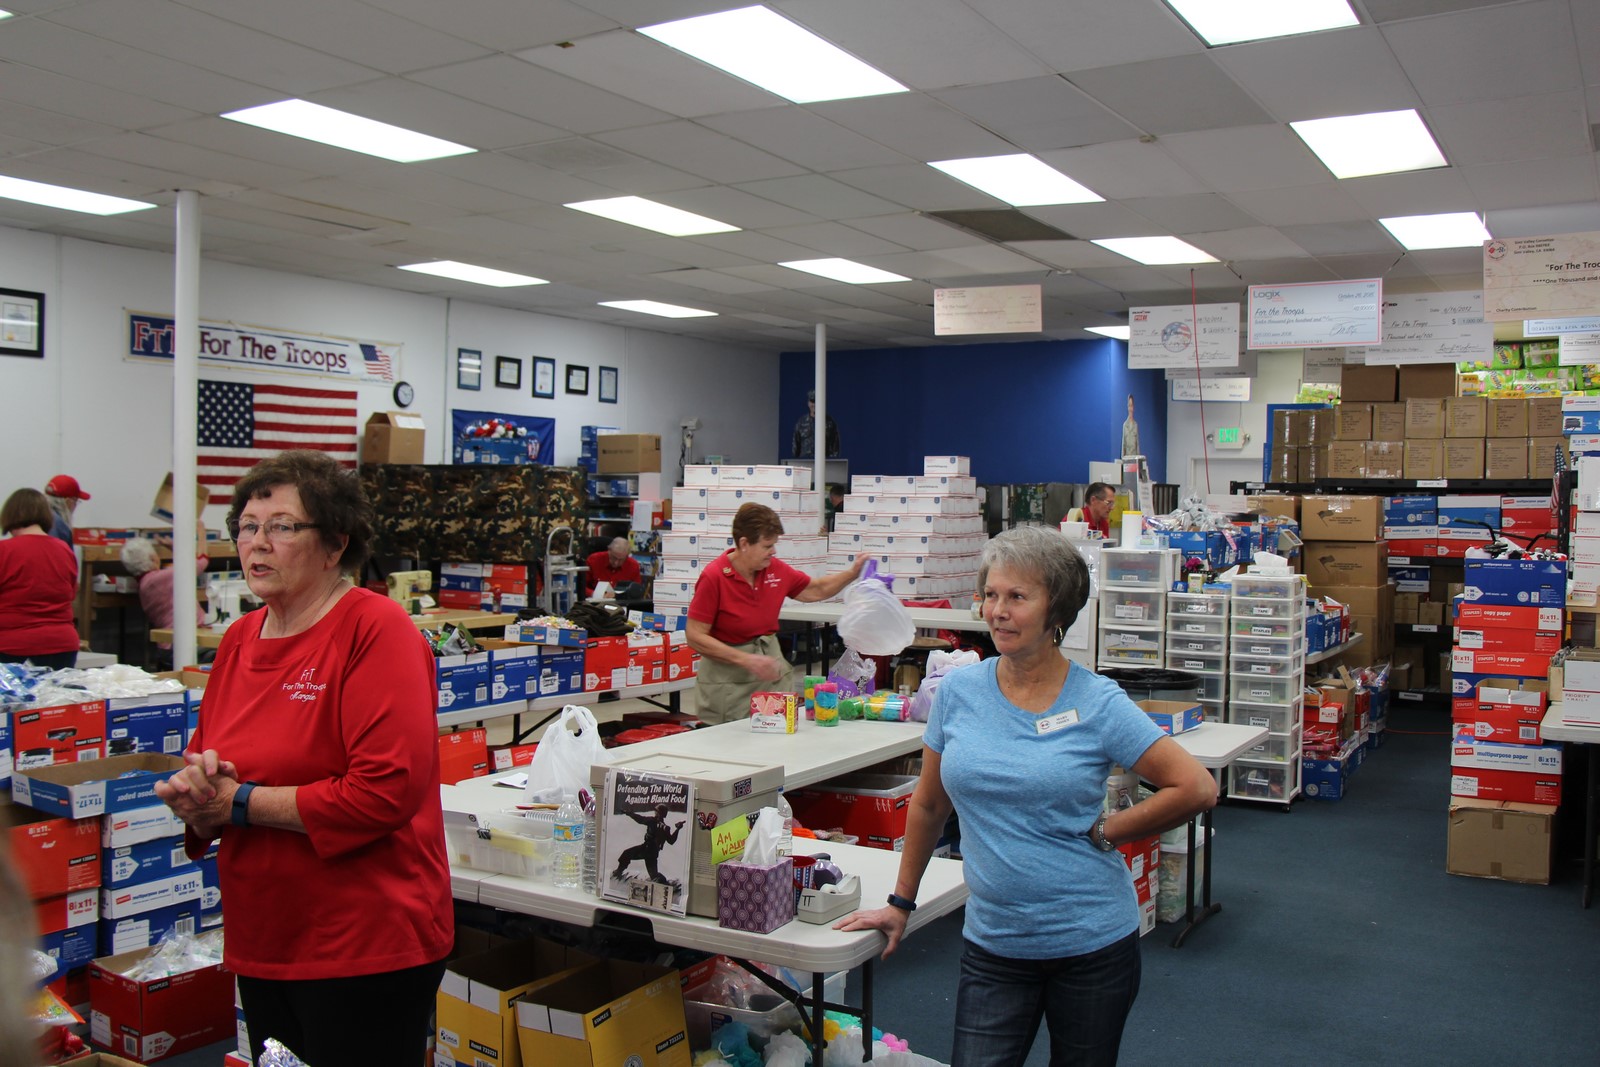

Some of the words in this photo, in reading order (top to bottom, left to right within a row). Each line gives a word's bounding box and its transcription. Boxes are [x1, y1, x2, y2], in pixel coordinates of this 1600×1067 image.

[1565, 262, 1580, 270] The
[1253, 290, 1280, 300] Logix
[1255, 308, 1268, 316] For
[1281, 306, 1305, 316] Troops
[200, 330, 231, 356] For
[238, 335, 277, 361] The
[282, 340, 348, 373] Troops
[1218, 427, 1240, 443] EXIT
[1121, 634, 1138, 643] Army
[1477, 751, 1511, 759] multipurpose
[616, 784, 649, 795] Defending
[650, 784, 662, 793] The
[662, 783, 683, 794] World
[117, 791, 136, 801] paper
[625, 794, 650, 805] Against
[650, 795, 669, 804] Bland
[670, 794, 687, 804] Food
[716, 832, 732, 846] AM
[148, 980, 169, 992] STAPLES
